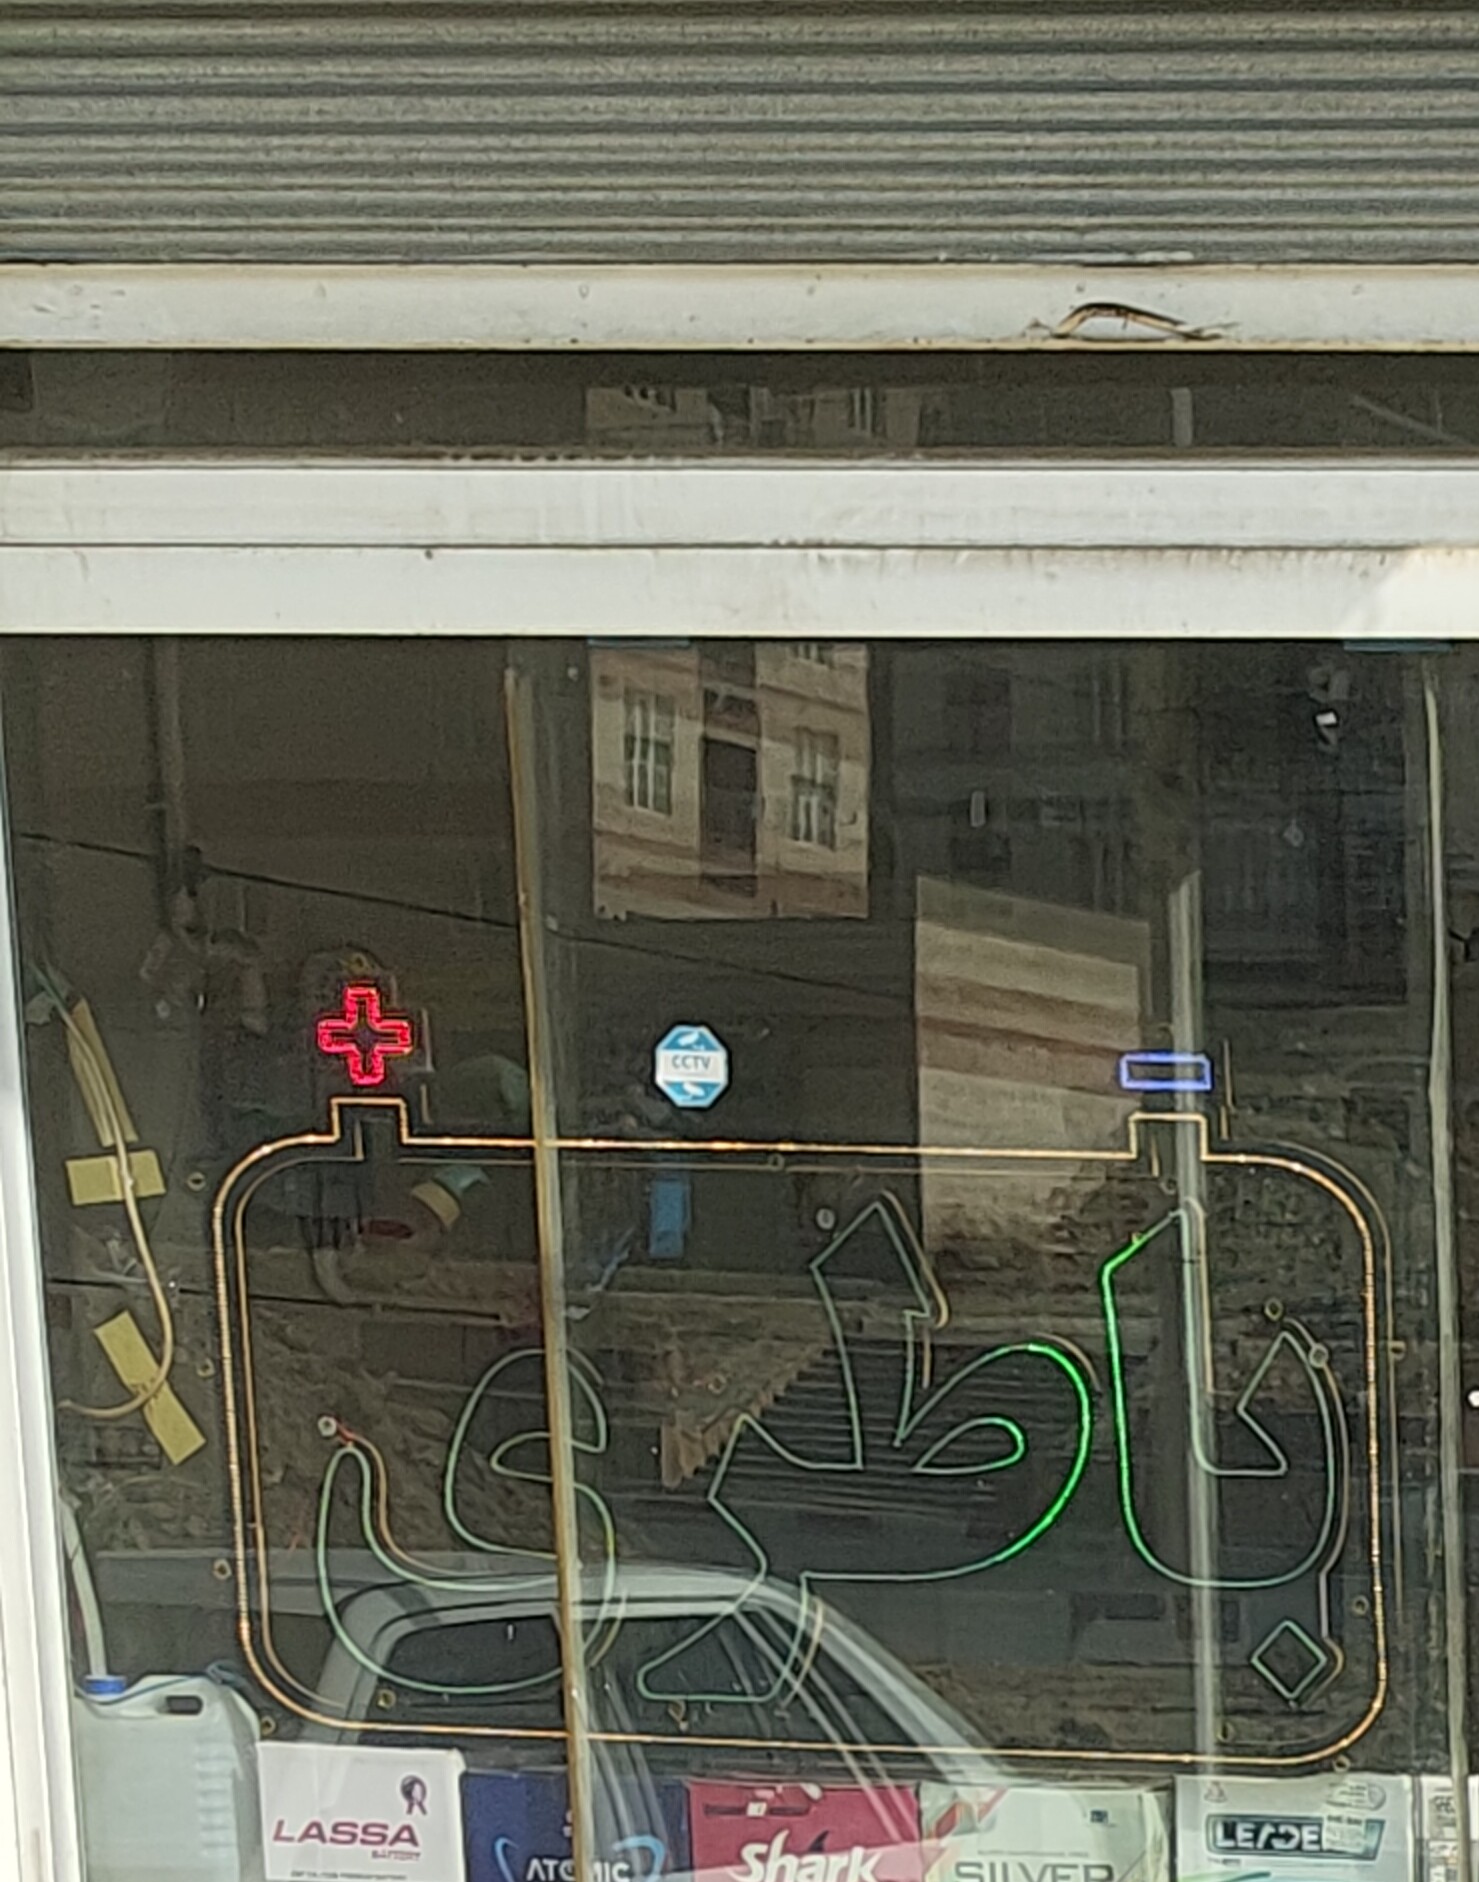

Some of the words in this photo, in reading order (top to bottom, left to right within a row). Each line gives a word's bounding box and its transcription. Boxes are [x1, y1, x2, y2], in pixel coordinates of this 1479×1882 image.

[671, 1054, 711, 1071] CCTV
[272, 1819, 420, 1847] LASSA
[1216, 1820, 1324, 1851] LEADE
